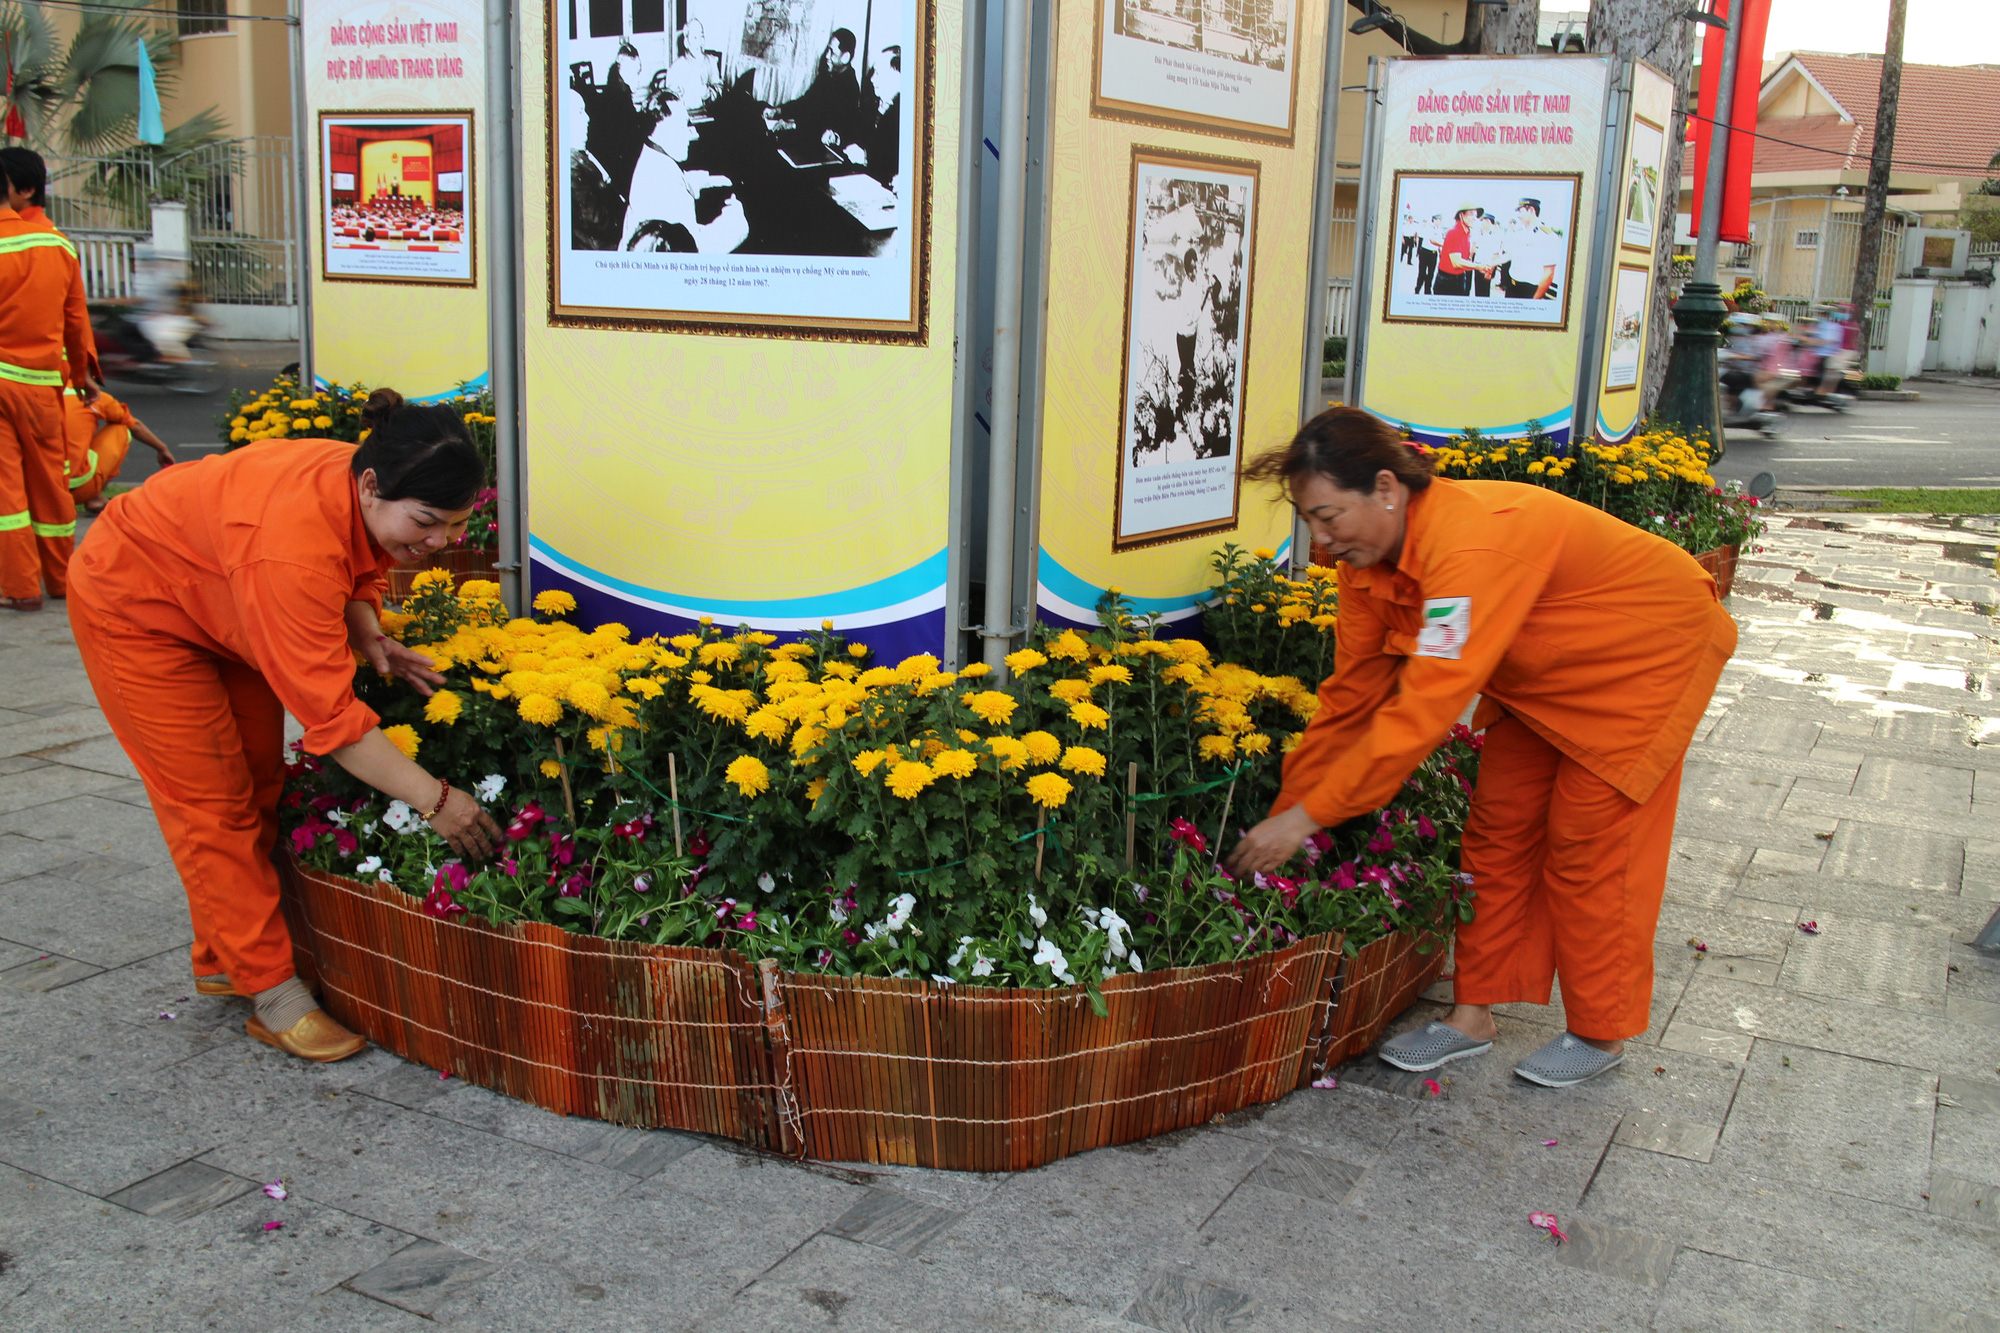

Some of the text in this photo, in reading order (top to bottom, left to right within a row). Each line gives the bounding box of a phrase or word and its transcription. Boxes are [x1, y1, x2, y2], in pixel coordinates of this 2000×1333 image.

[331, 16, 458, 49] ĐẢNG CỘNG SẢN VIỆT NAM
[327, 52, 463, 84] RỰC RỠ NHỮNG TRANG VÀNG
[1418, 88, 1571, 116] ĐẢNG CỘNG SẢN VIỆT NAM
[1410, 122, 1574, 147] RỰC RỠ NHỮNG TRANG VÀNG
